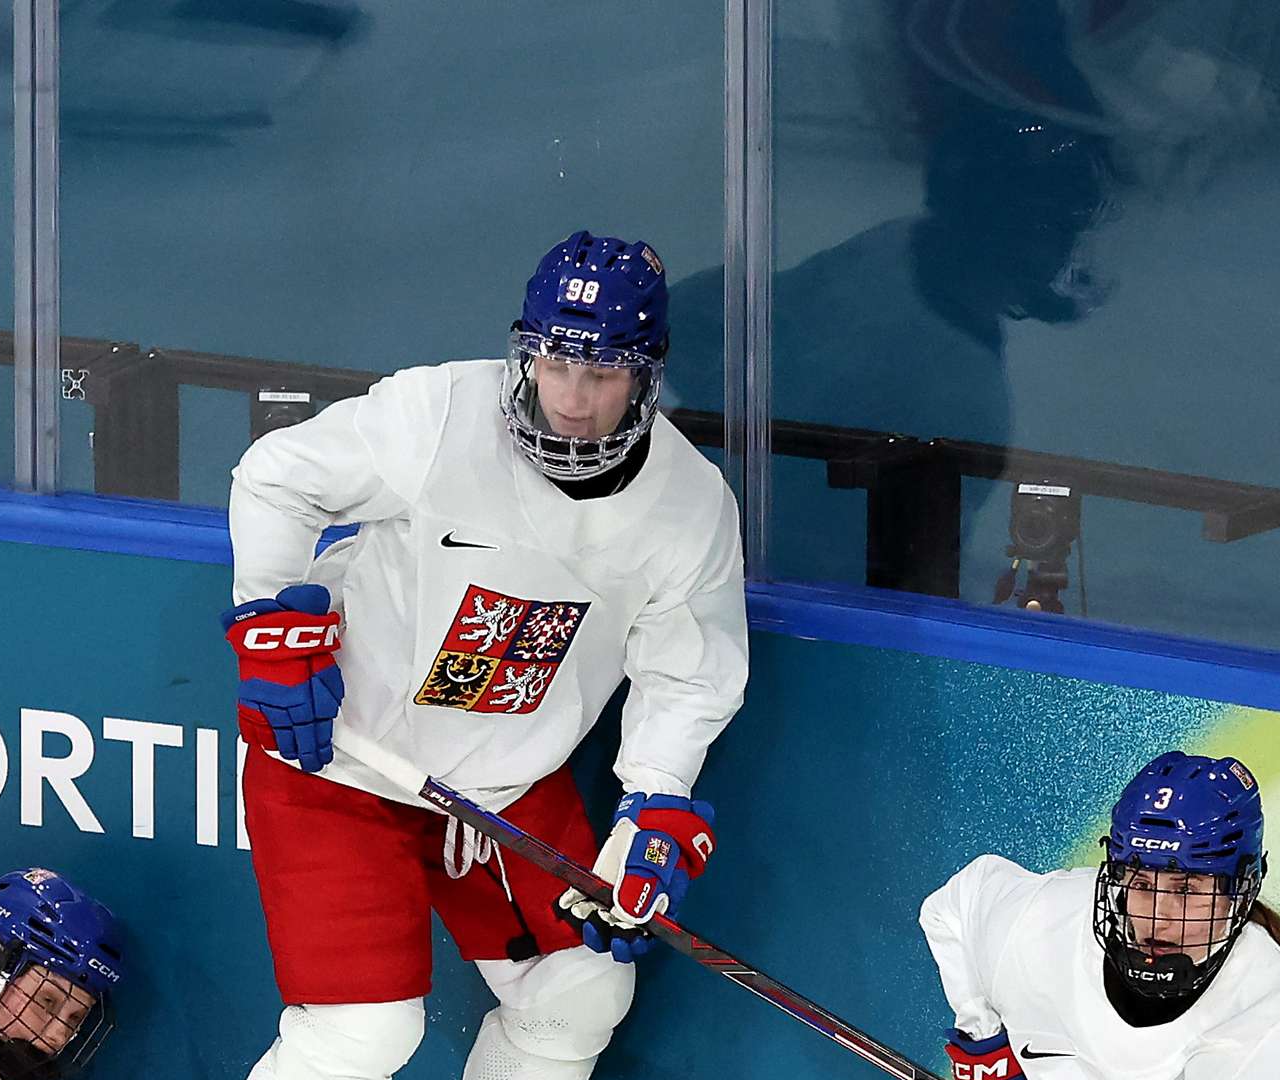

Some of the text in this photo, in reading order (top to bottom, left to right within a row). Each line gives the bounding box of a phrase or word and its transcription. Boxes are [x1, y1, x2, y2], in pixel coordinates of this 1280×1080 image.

[566, 278, 600, 304] 98
[550, 325, 601, 342] CCM
[1154, 788, 1173, 810] 3
[1131, 837, 1180, 851] CCM
[634, 882, 651, 914] CCM
[88, 957, 120, 984] CCM
[952, 1058, 1009, 1080] CM
